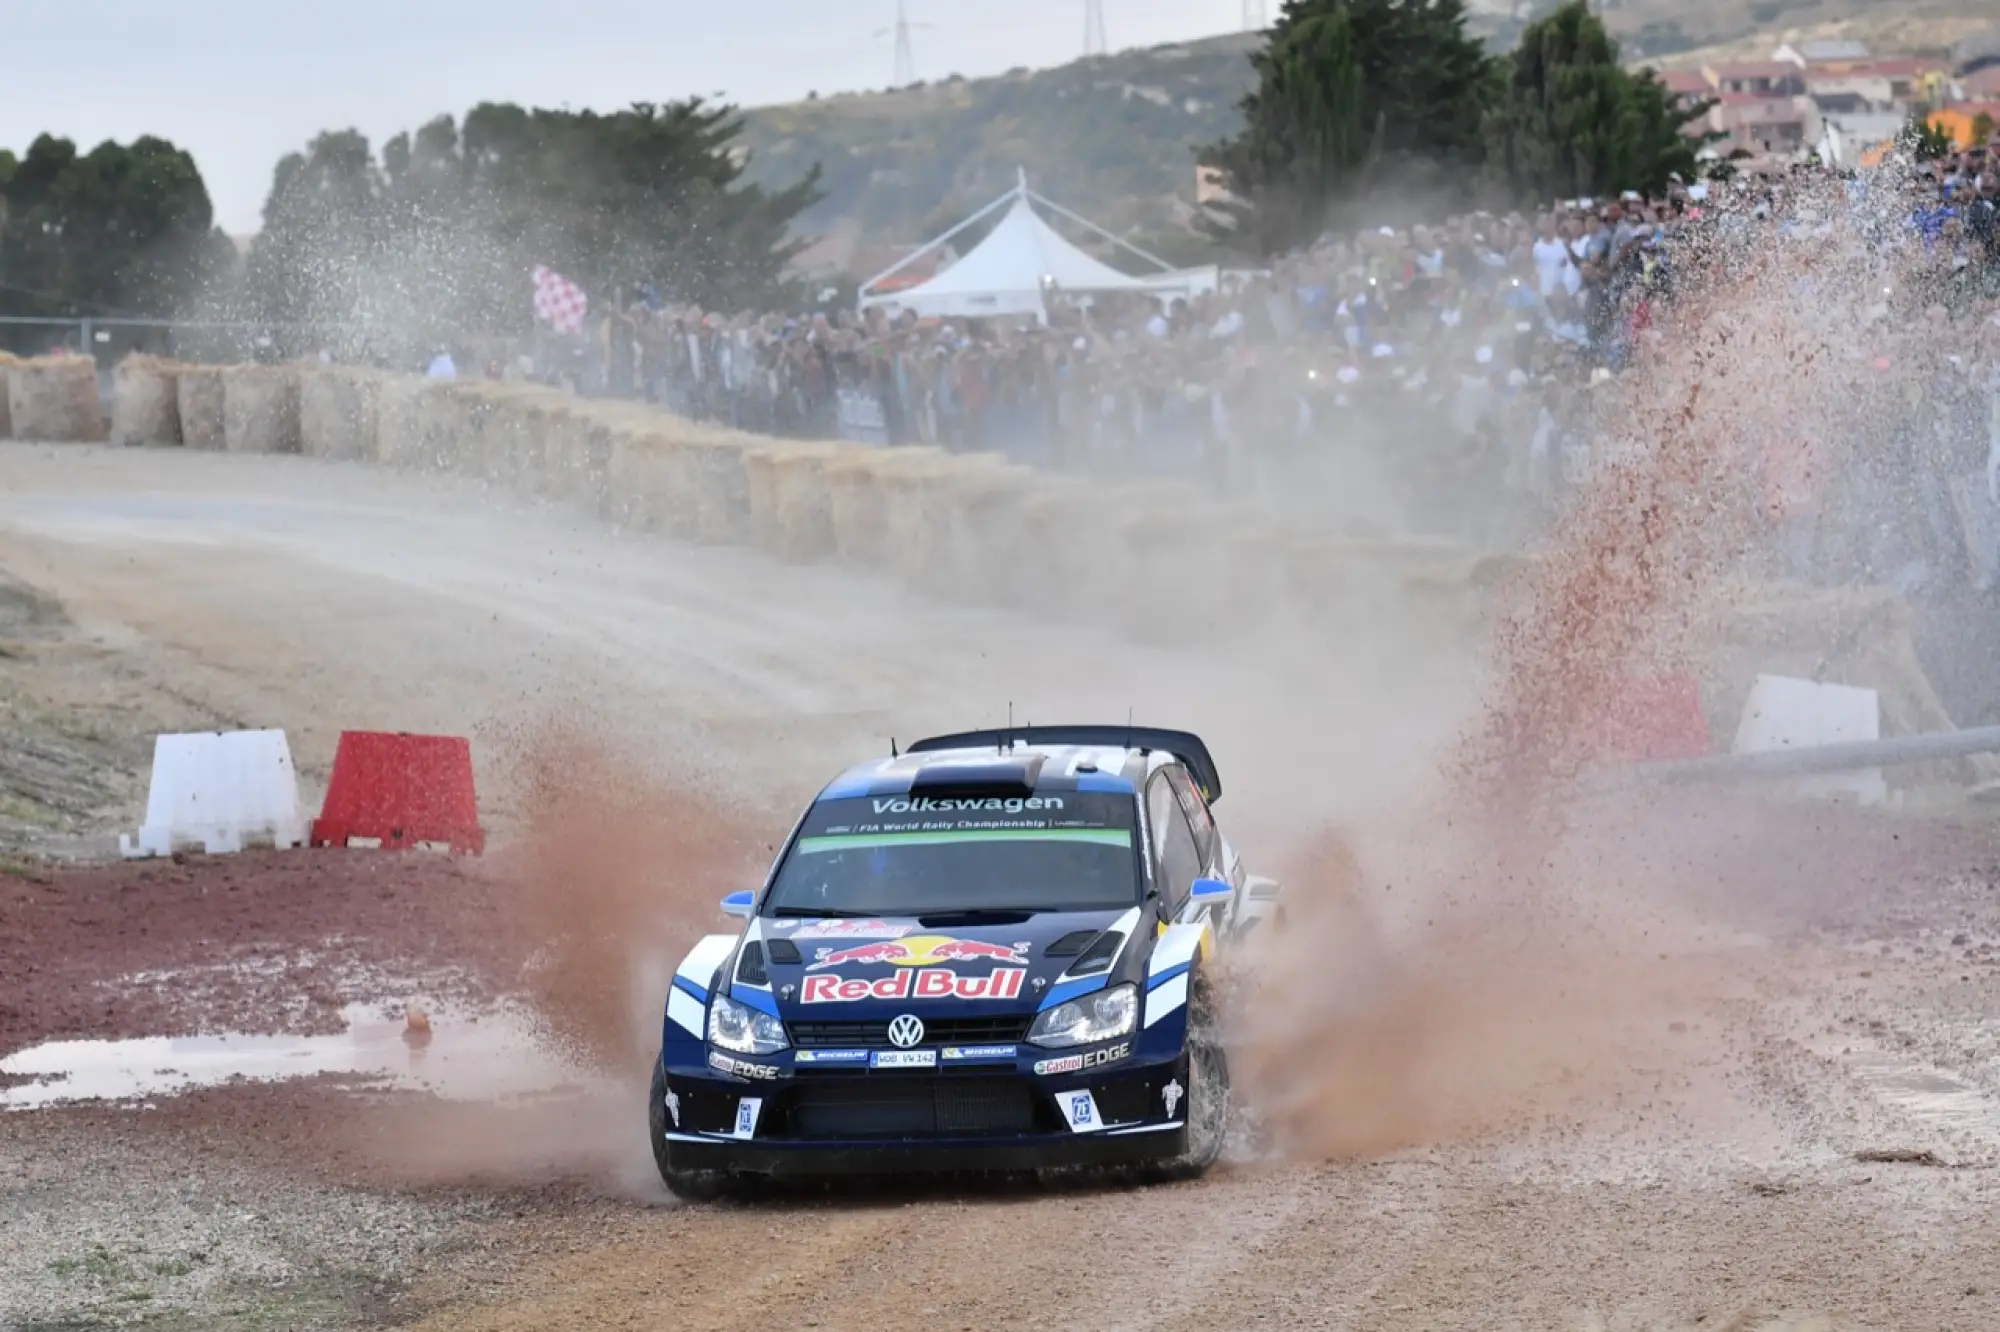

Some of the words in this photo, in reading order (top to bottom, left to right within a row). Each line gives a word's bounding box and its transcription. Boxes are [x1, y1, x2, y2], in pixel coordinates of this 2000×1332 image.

[872, 797, 1064, 814] Volkswagen
[859, 822, 879, 832] FIA
[883, 821, 920, 831] World
[922, 819, 954, 830] Rally
[957, 819, 1046, 830] Championship
[800, 968, 913, 1004] Red
[912, 967, 1027, 999] Bull
[1046, 1057, 1082, 1073] Castrol
[1083, 1042, 1131, 1068] EDGE
[733, 1060, 781, 1080] EDGE
